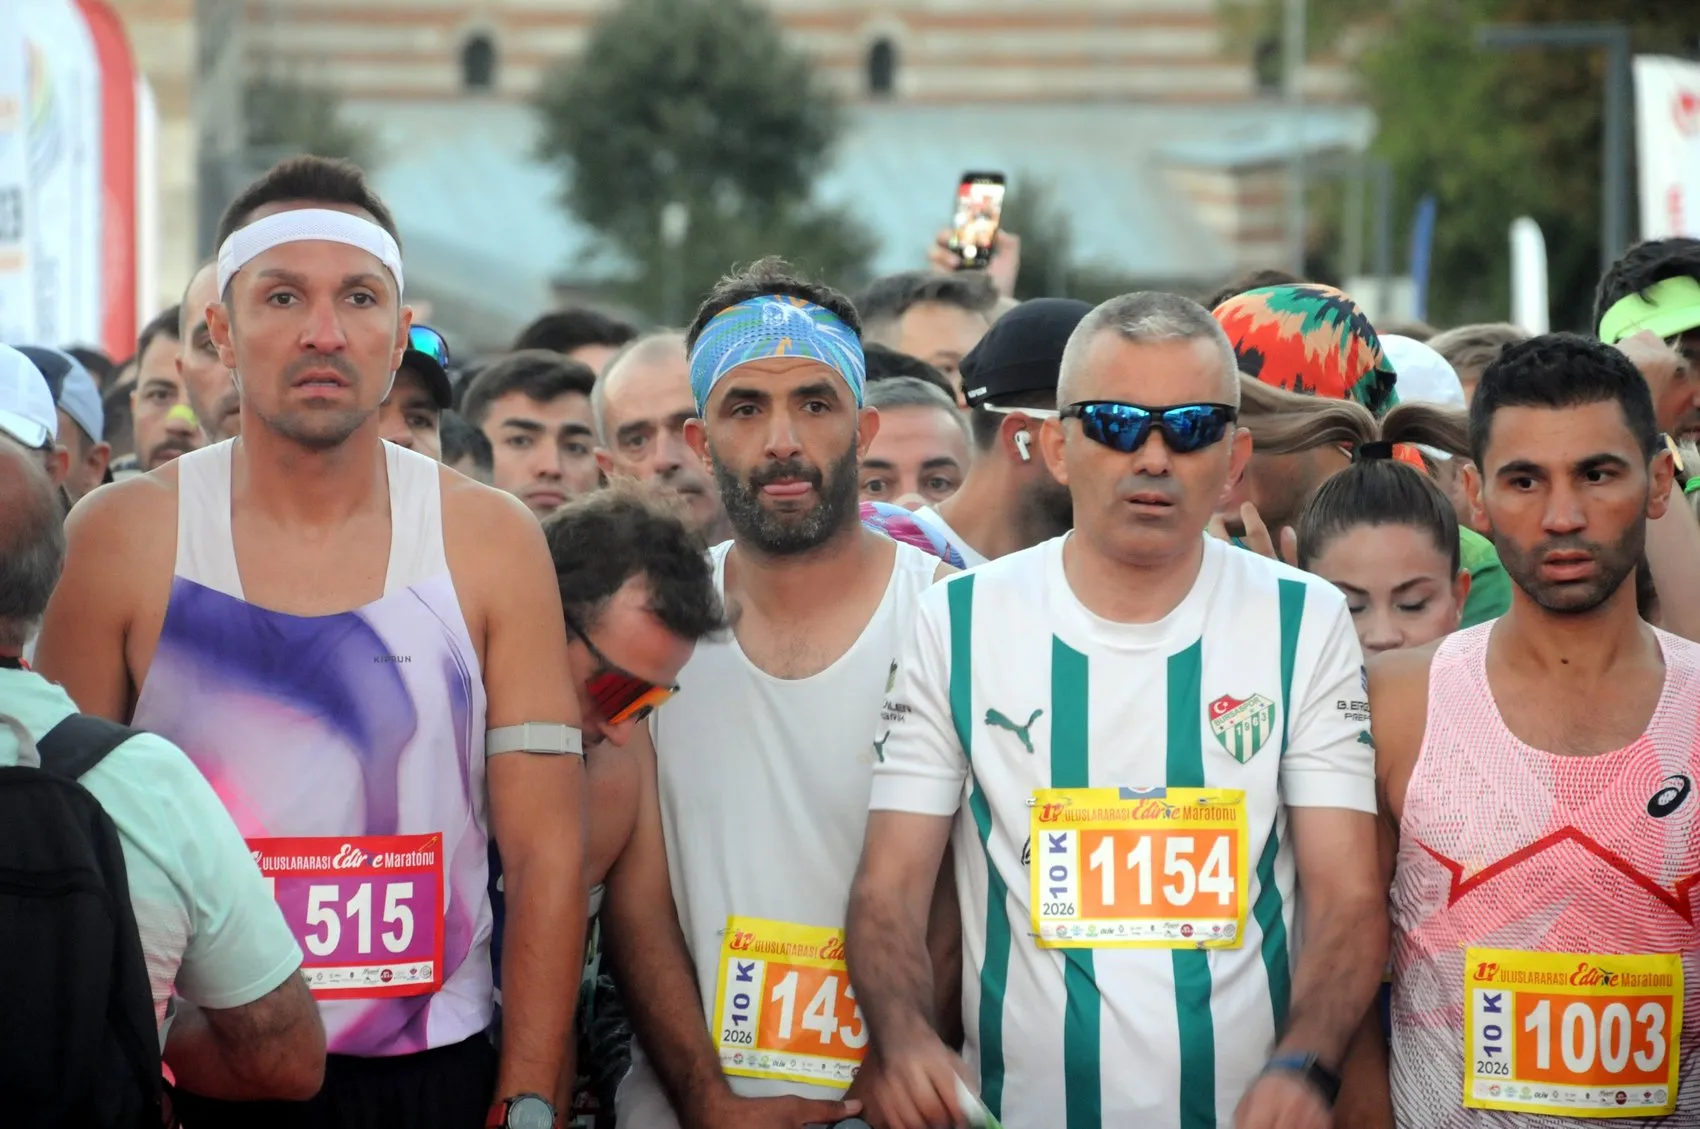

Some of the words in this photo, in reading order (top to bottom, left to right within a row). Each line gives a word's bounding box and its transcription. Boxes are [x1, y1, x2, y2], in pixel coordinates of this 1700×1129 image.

[373, 655, 412, 664] KIPRUN
[1213, 696, 1261, 726] BURSASPOR
[1065, 807, 1130, 822] ULUSLARARASI
[1182, 806, 1237, 822] Maratonu
[1049, 833, 1067, 854] K
[263, 855, 331, 871] ULUSLARARASI
[384, 850, 435, 869] Maratonu
[1089, 836, 1234, 907] 1154
[1049, 866, 1067, 899] 10
[304, 881, 414, 956] 515
[1043, 903, 1074, 916] 2026
[755, 940, 818, 959] ULUSLARARASI
[735, 960, 756, 983] K
[1500, 970, 1568, 985] ULUSLARARASI
[1621, 972, 1673, 988] Maratonu
[731, 993, 750, 1026] 10
[1483, 992, 1502, 1014] K
[723, 1029, 752, 1045] 2026
[1483, 1024, 1502, 1057] 10
[1524, 999, 1667, 1074] 1003
[1477, 1060, 1509, 1076] 2026
